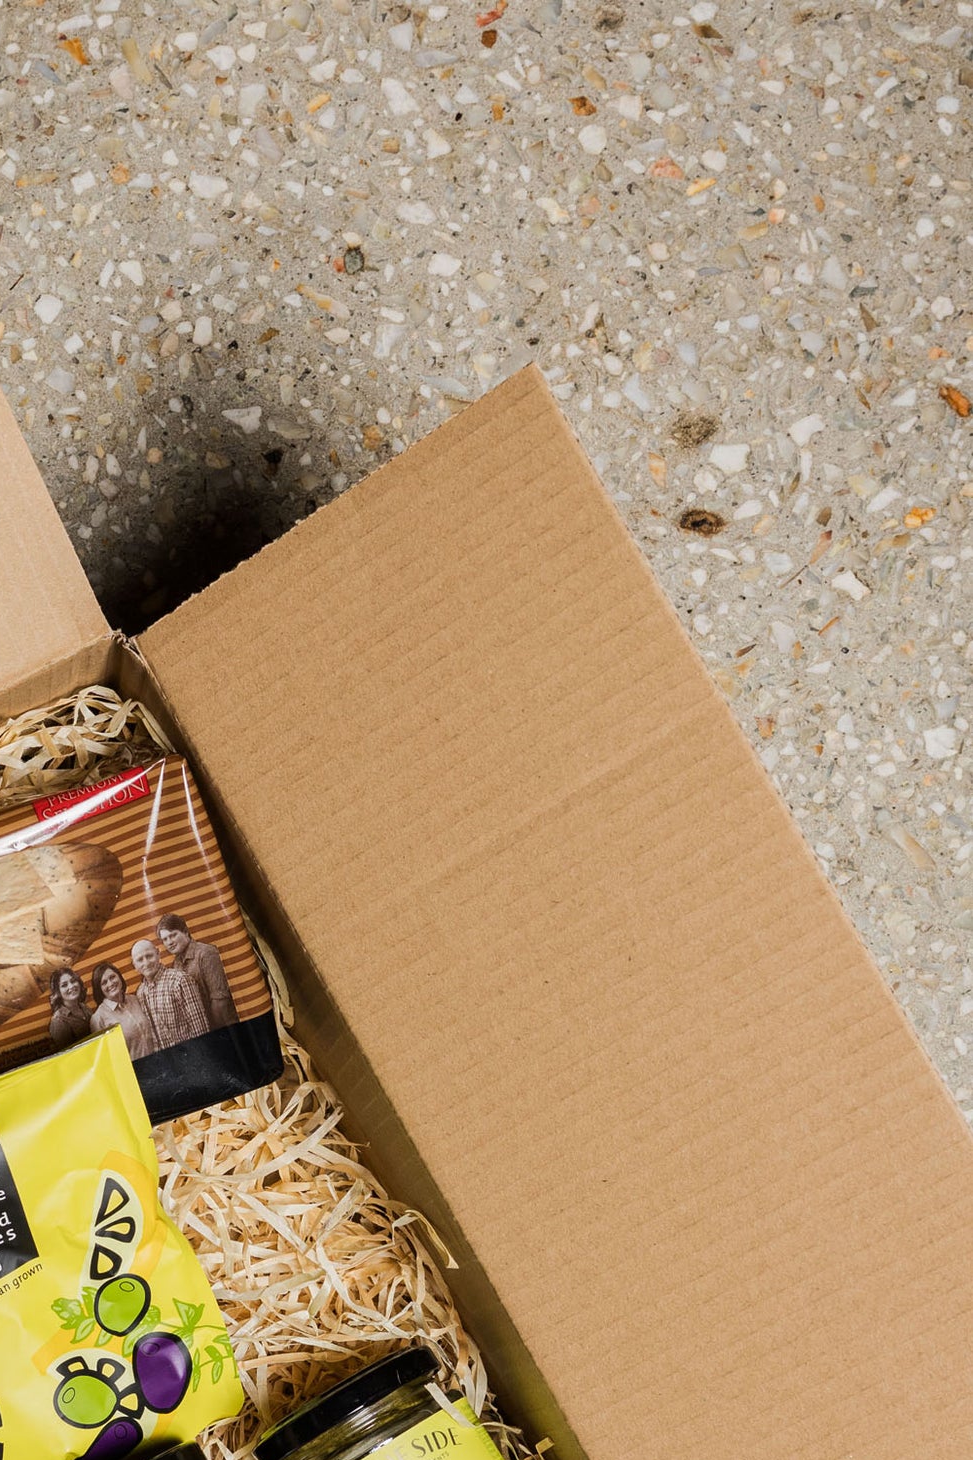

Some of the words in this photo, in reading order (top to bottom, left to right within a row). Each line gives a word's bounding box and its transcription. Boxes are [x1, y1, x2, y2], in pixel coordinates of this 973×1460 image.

[48, 774, 123, 807] PREMIUM
[12, 1262, 43, 1289] grown
[411, 1427, 463, 1458] SIDE
